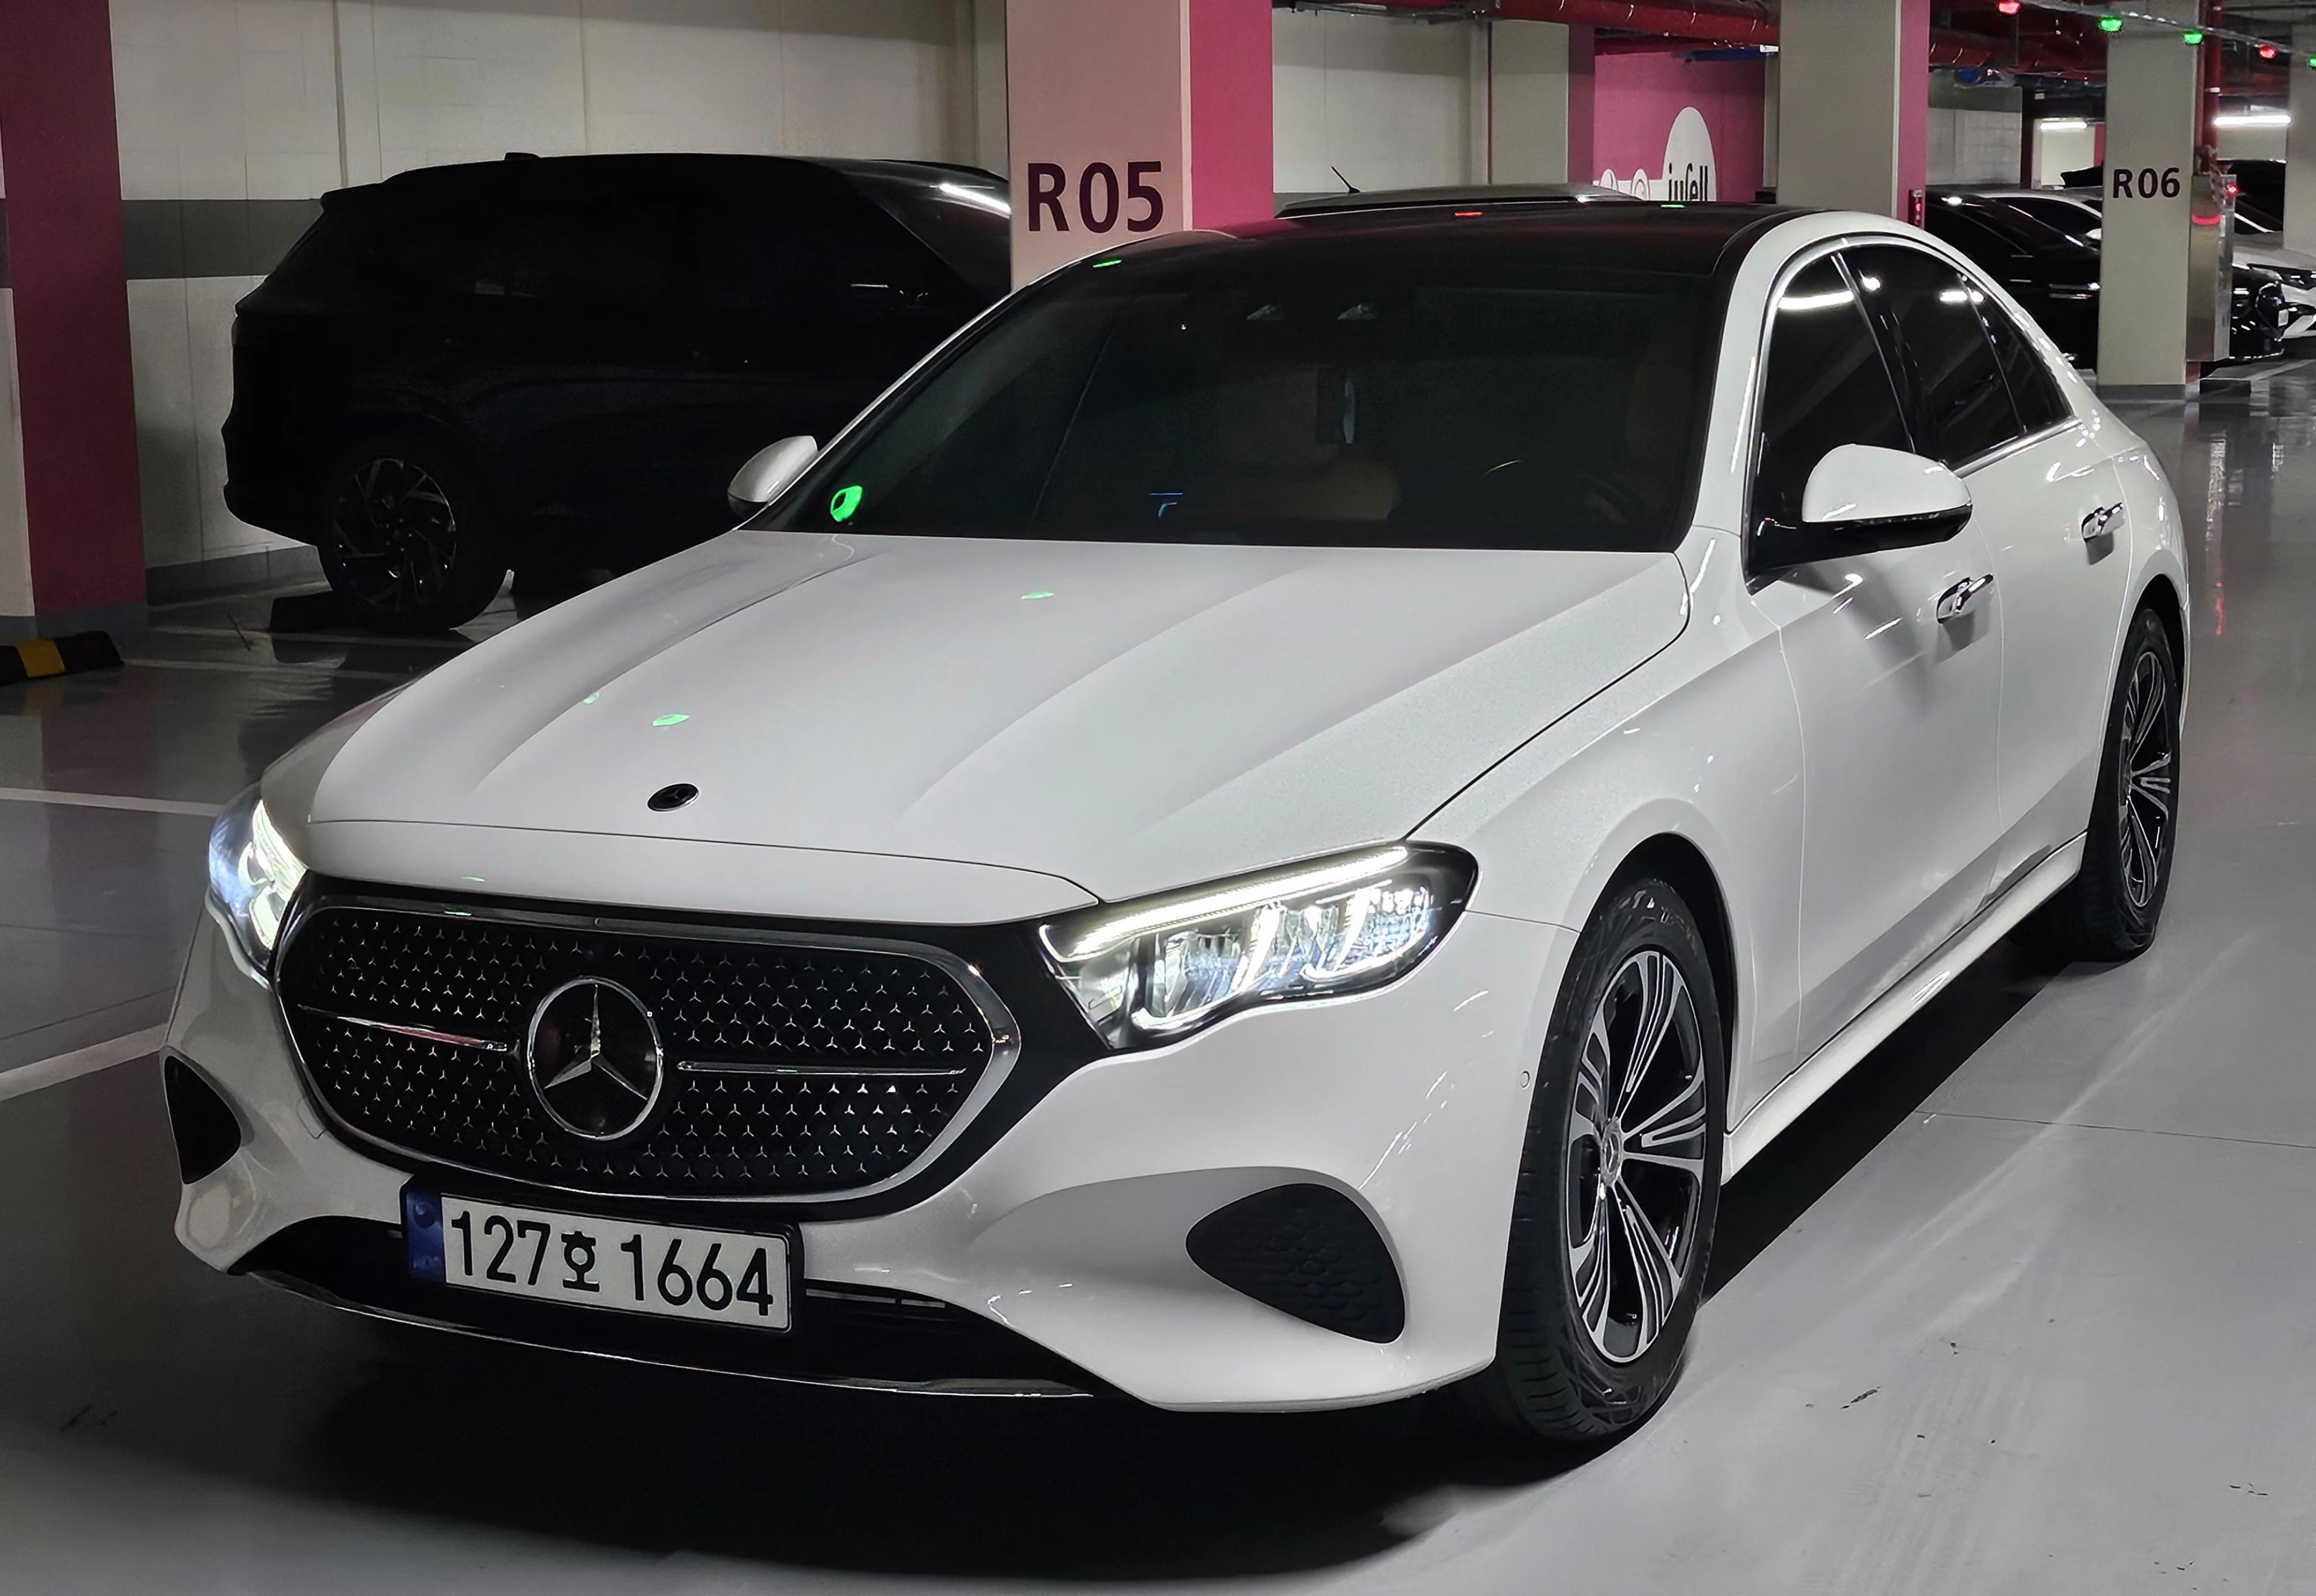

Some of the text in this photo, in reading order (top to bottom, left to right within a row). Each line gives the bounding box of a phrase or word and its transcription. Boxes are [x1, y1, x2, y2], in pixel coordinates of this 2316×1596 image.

[1027, 160, 1164, 234] R05
[2112, 167, 2180, 199] R06
[451, 1210, 774, 1316] 127호 1664
